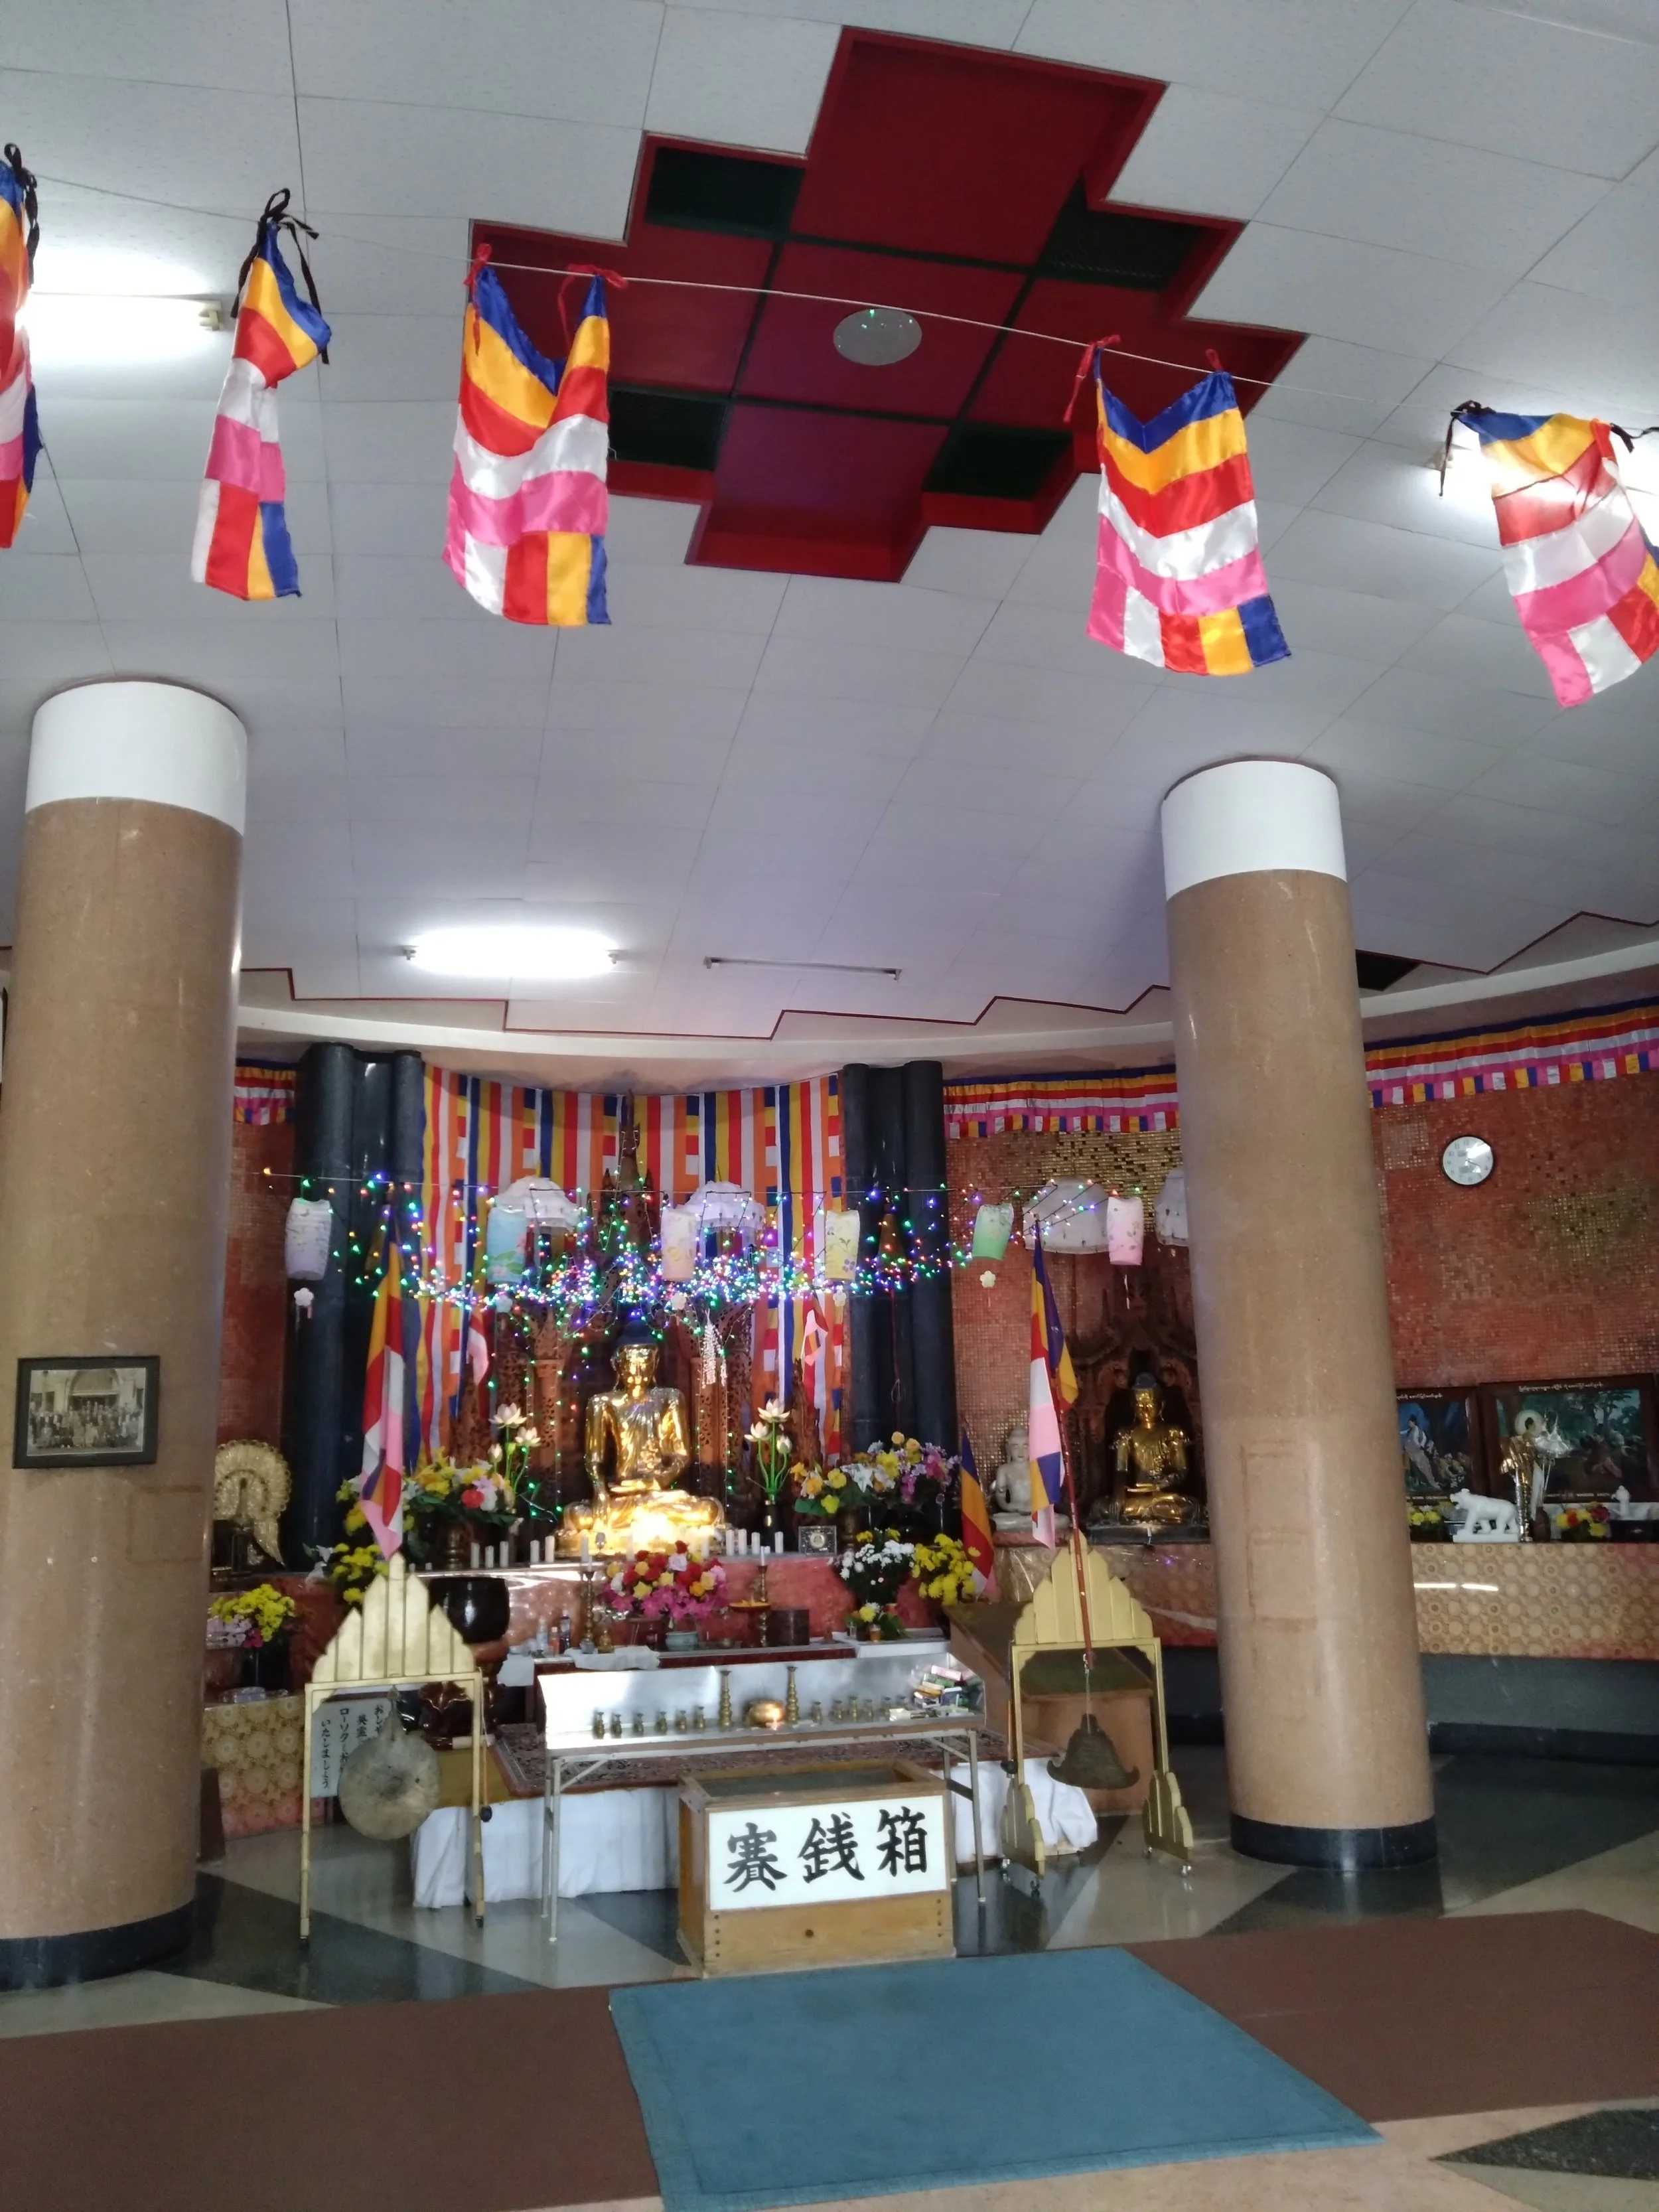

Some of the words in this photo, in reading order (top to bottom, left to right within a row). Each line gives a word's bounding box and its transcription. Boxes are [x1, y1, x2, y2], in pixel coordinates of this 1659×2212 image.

[321, 1720, 330, 1789] いたしましょう
[723, 1806, 927, 1892] 賽銭箱
